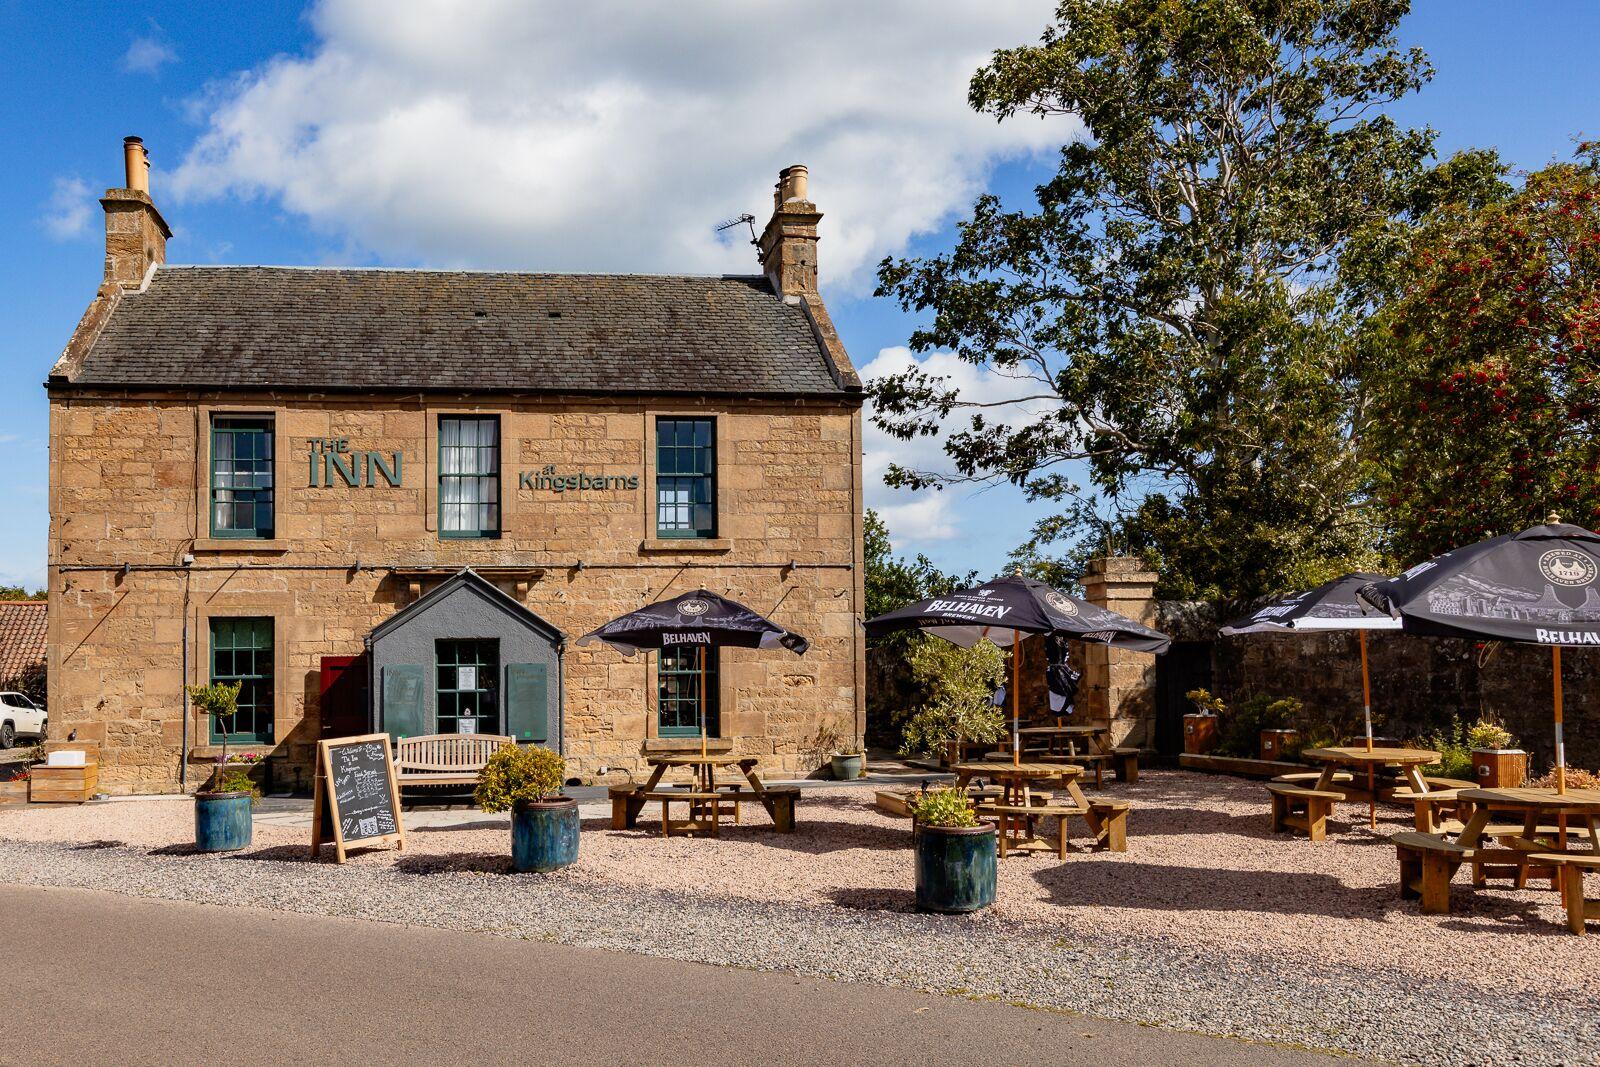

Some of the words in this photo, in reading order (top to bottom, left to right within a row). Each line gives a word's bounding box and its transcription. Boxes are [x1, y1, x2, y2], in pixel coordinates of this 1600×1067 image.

[306, 436, 350, 453] THE
[307, 451, 403, 488] INN
[542, 464, 556, 476] at
[518, 470, 640, 494] Kingsbarns
[924, 600, 1012, 619] BELHAVEN
[942, 612, 977, 620] BREWERY
[662, 631, 711, 646] BELHAVEN
